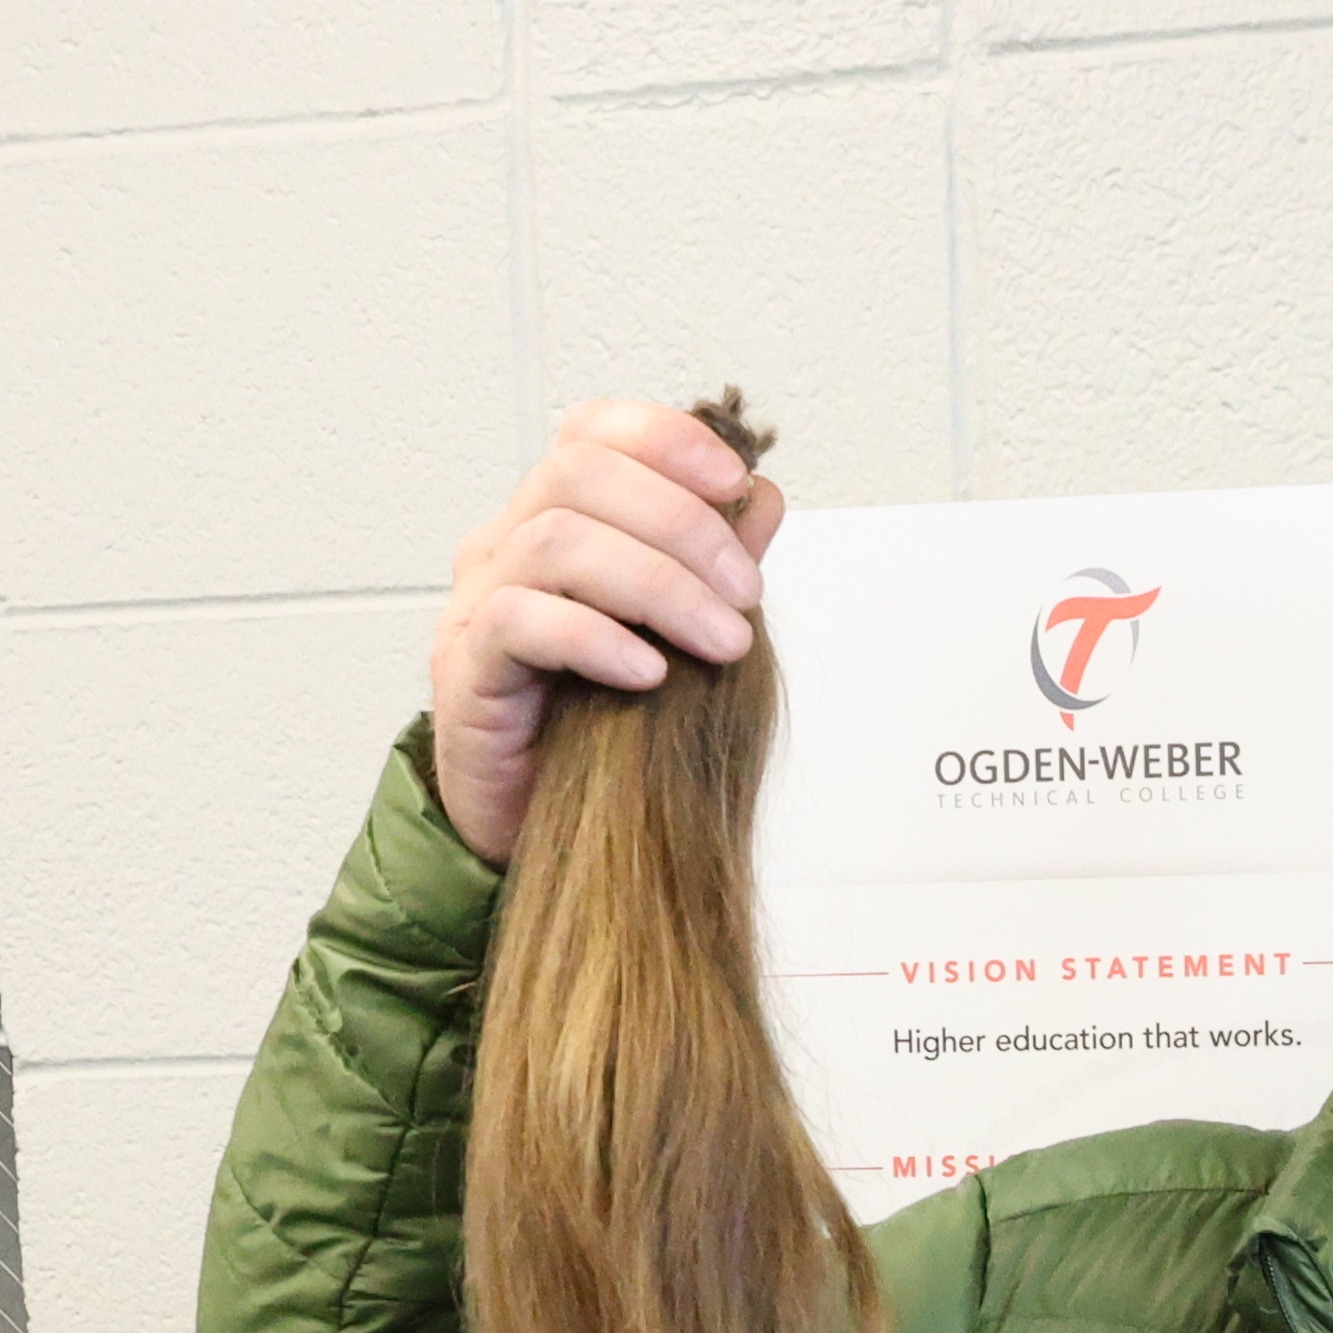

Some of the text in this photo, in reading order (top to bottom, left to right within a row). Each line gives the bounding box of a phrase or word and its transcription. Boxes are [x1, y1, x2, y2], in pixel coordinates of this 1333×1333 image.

[934, 741, 1244, 786] OGDEN-WEBER
[936, 783, 1246, 810] TECHNICAL COLLEGE
[900, 952, 1293, 984] VISION STATEMENT
[892, 1020, 1303, 1061] Higher education that works.
